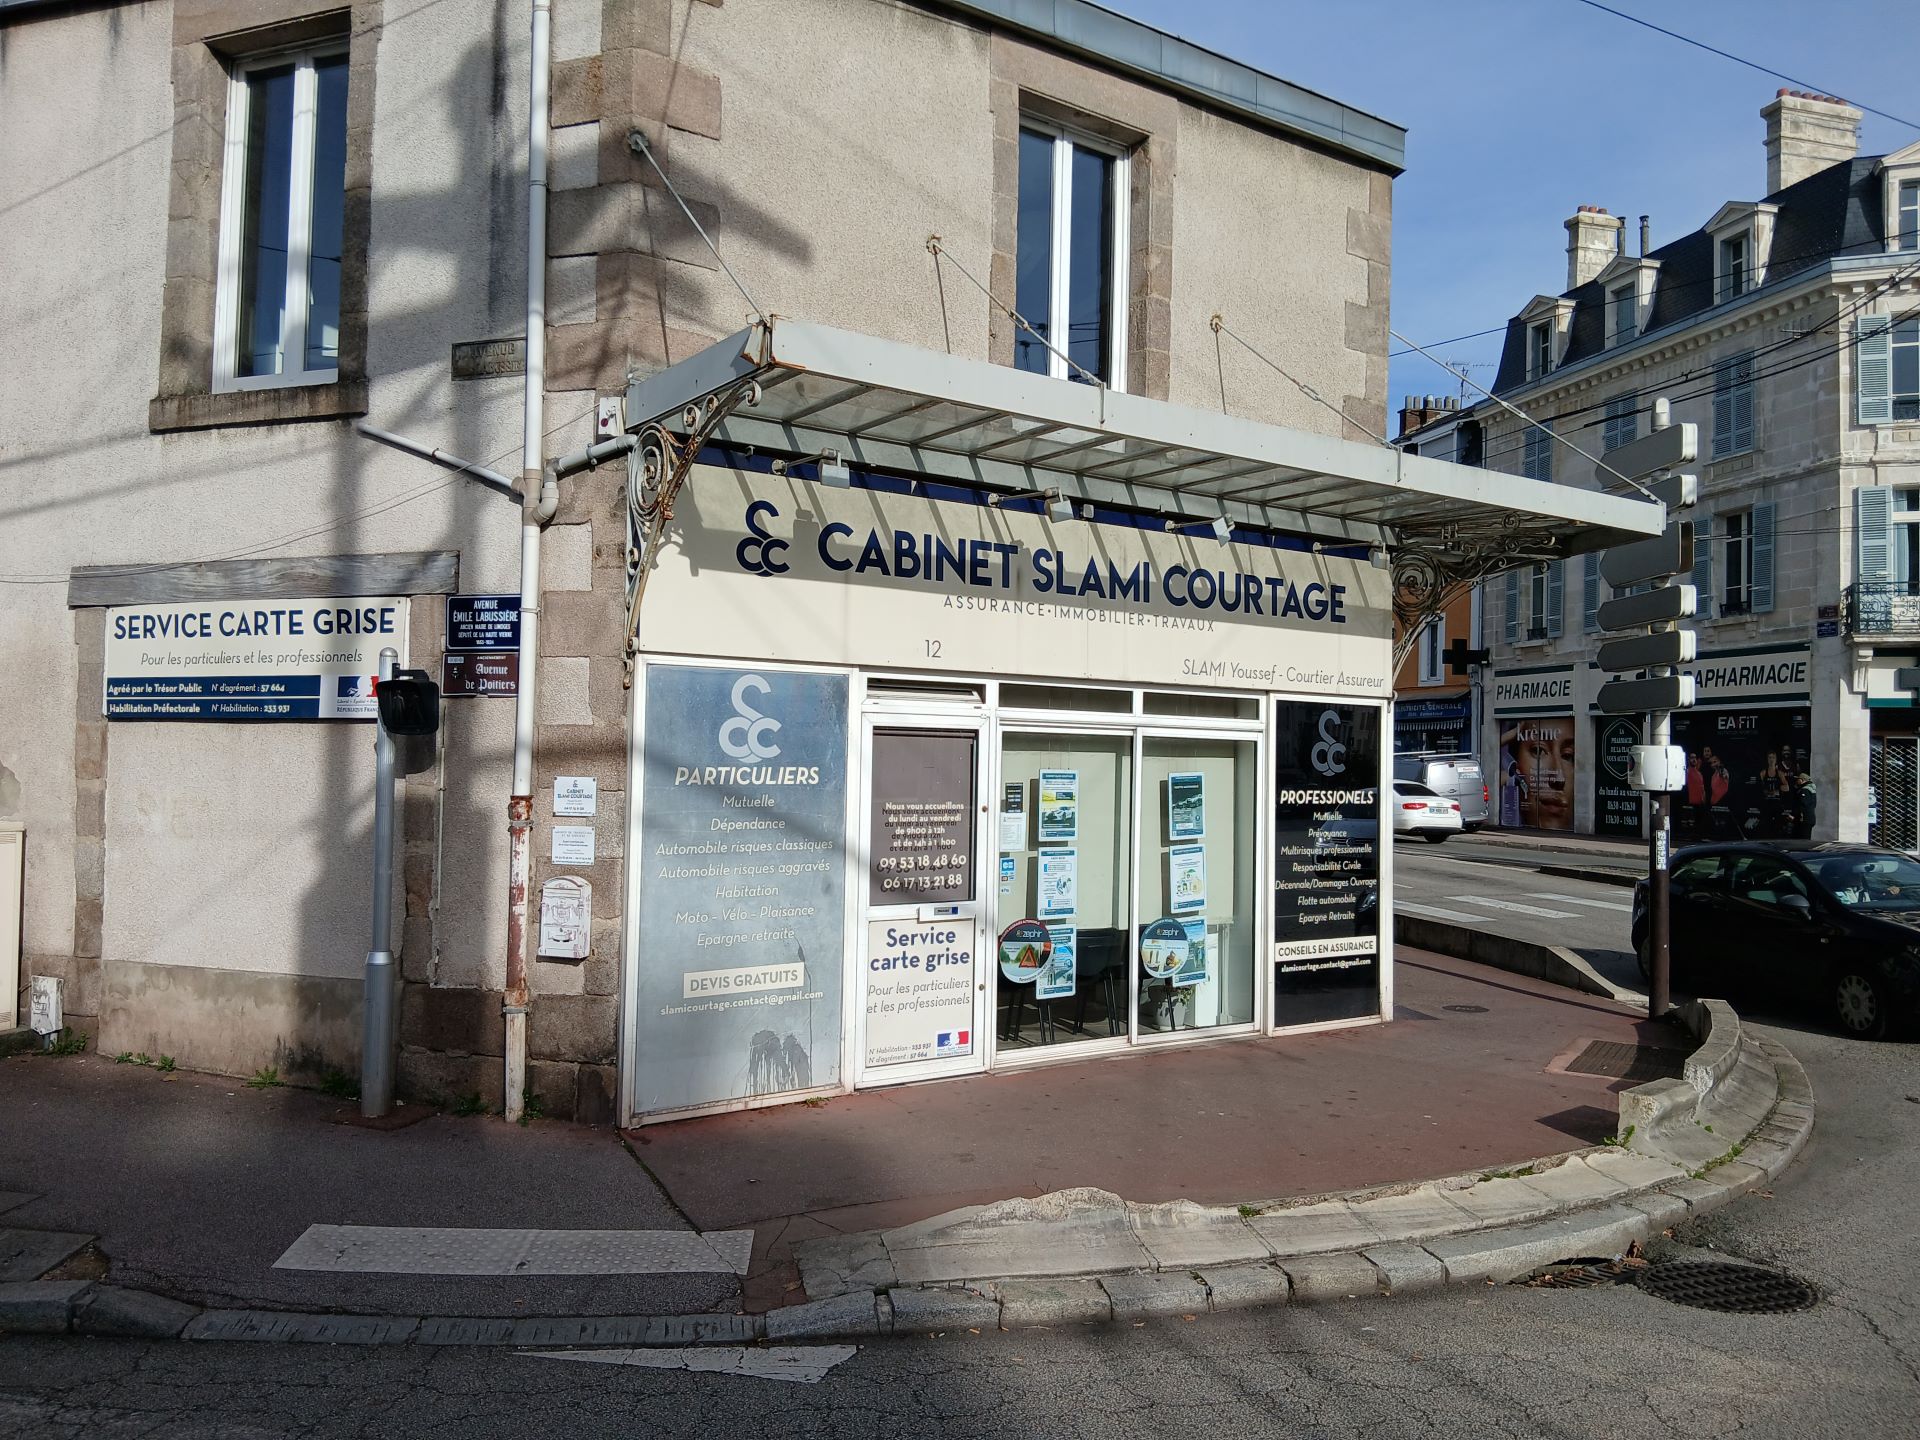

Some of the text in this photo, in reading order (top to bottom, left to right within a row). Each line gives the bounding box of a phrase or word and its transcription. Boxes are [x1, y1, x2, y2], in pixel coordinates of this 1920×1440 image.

[818, 522, 1346, 623] CABINET SLAMI COURTAGE
[473, 600, 499, 610] AVENUE
[453, 609, 519, 622] ÉMILE LABUSSIÈRE
[114, 608, 395, 640] SERVICE CARTE GRISE
[925, 640, 941, 658] 12
[141, 649, 362, 668] Pour les particuliers et les professionnels
[475, 663, 509, 675] Avenue
[1182, 658, 1384, 688] SLAMI Youssef Courtier Assureur
[108, 682, 202, 696] Agréé par le Trésor Public
[220, 683, 256, 694] d'agrément
[261, 684, 270, 692] 57
[270, 683, 286, 692] 664
[465, 678, 516, 691] de Poitiers
[1496, 679, 1571, 700] PHARMACIE
[109, 703, 200, 713] Habilitation Préfectorale
[220, 703, 259, 713] Habilitation
[264, 705, 277, 713] 233
[675, 766, 819, 786] PARTICULIERS
[722, 794, 775, 808] Mutuelle
[886, 802, 905, 810] Nous
[925, 801, 965, 810] accueillons
[888, 814, 898, 823] du
[899, 814, 918, 822] lundi
[930, 813, 962, 822] vendredi
[1313, 811, 1343, 821] Mutuelle
[711, 817, 786, 833] Dépendance
[895, 827, 905, 835] de
[906, 826, 926, 835] 9h00
[933, 826, 946, 834] 12h
[1308, 828, 1347, 840] Prévoyance
[656, 837, 833, 856] Automobile risques classiques
[903, 839, 913, 847] de
[914, 838, 927, 847] 14h
[1280, 843, 1372, 858] Multirisques professionnelle
[880, 853, 967, 869] 09 53 18 48 60
[1292, 860, 1361, 874] Responsabilité Civile
[659, 859, 831, 879] Automobile risques aggravés
[884, 873, 963, 889] 06 17 13 21 88
[1350, 876, 1377, 888] Ouvrage
[715, 885, 779, 899] Habitation
[1297, 893, 1356, 906] Flotte automobile
[675, 905, 815, 925] Moto Vélo Plaisance
[1299, 911, 1355, 925] Epargne Retraite
[697, 927, 795, 948] Epargne retraite
[886, 926, 956, 948] Service
[1278, 940, 1374, 957] CONSEILS EN ASSURANCE
[870, 947, 971, 973] carte grise
[690, 969, 798, 992] DEVIS GRATUITS
[868, 977, 970, 997] Pour les particuliers
[660, 990, 824, 1016] slamicourtage.contact@gmail.com
[867, 993, 970, 1014] et les professionnels
